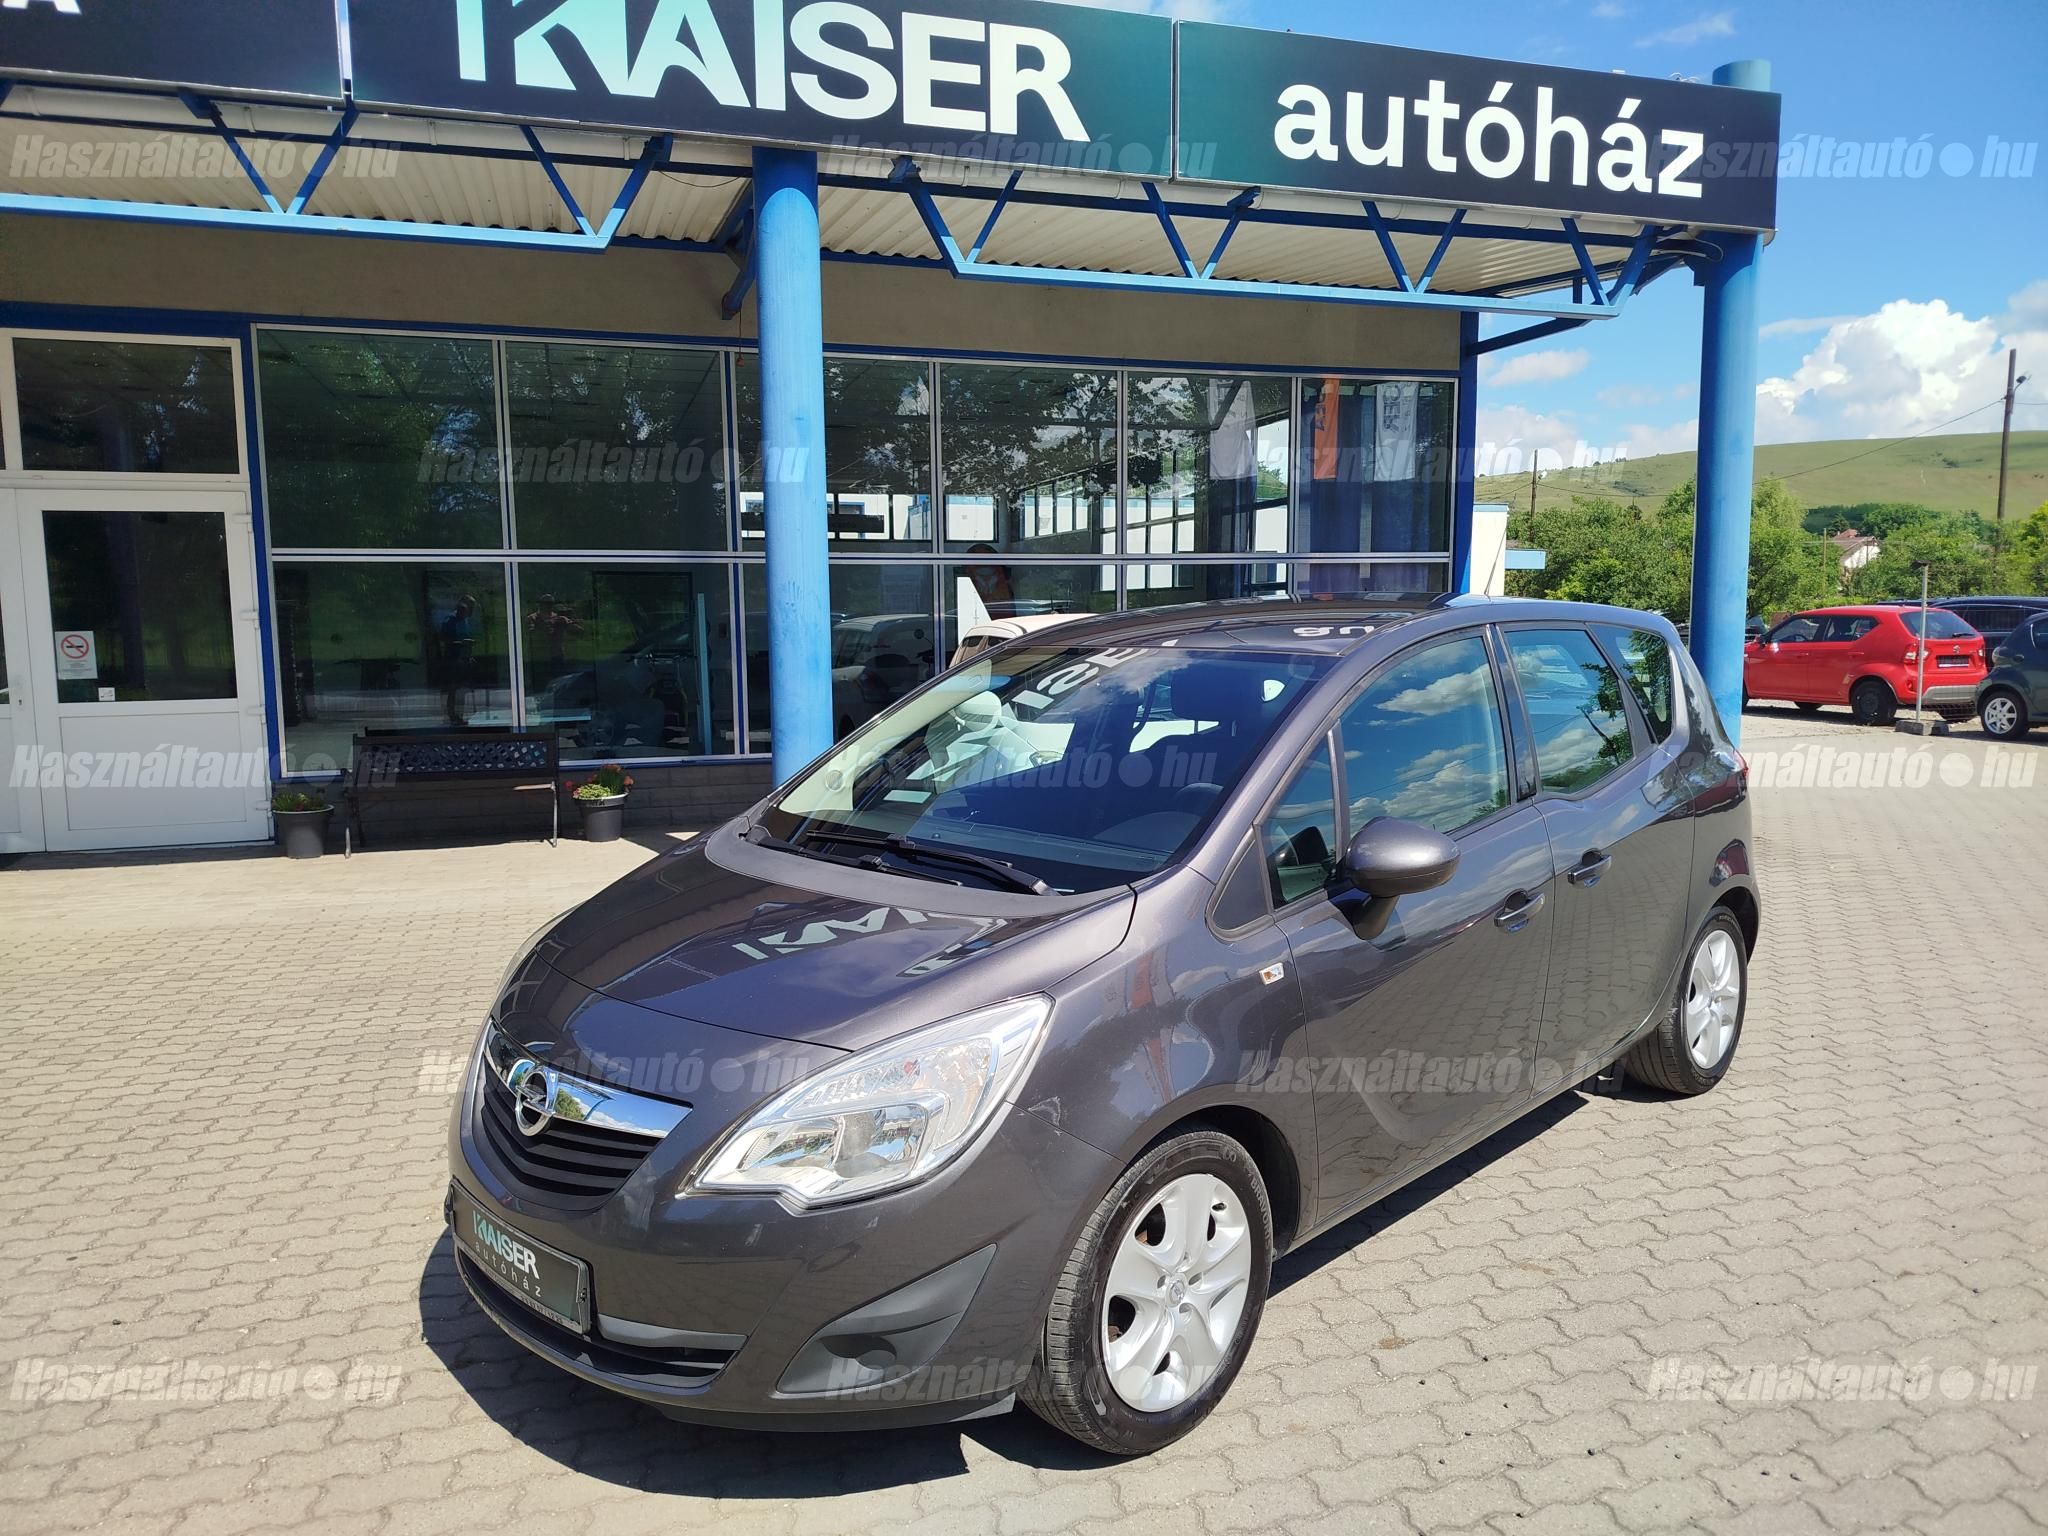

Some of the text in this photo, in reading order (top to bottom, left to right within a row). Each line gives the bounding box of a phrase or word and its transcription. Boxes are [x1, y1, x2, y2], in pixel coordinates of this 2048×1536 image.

[456, 0, 1704, 198] KAISER autóház
[472, 1210, 540, 1280] KAISER
